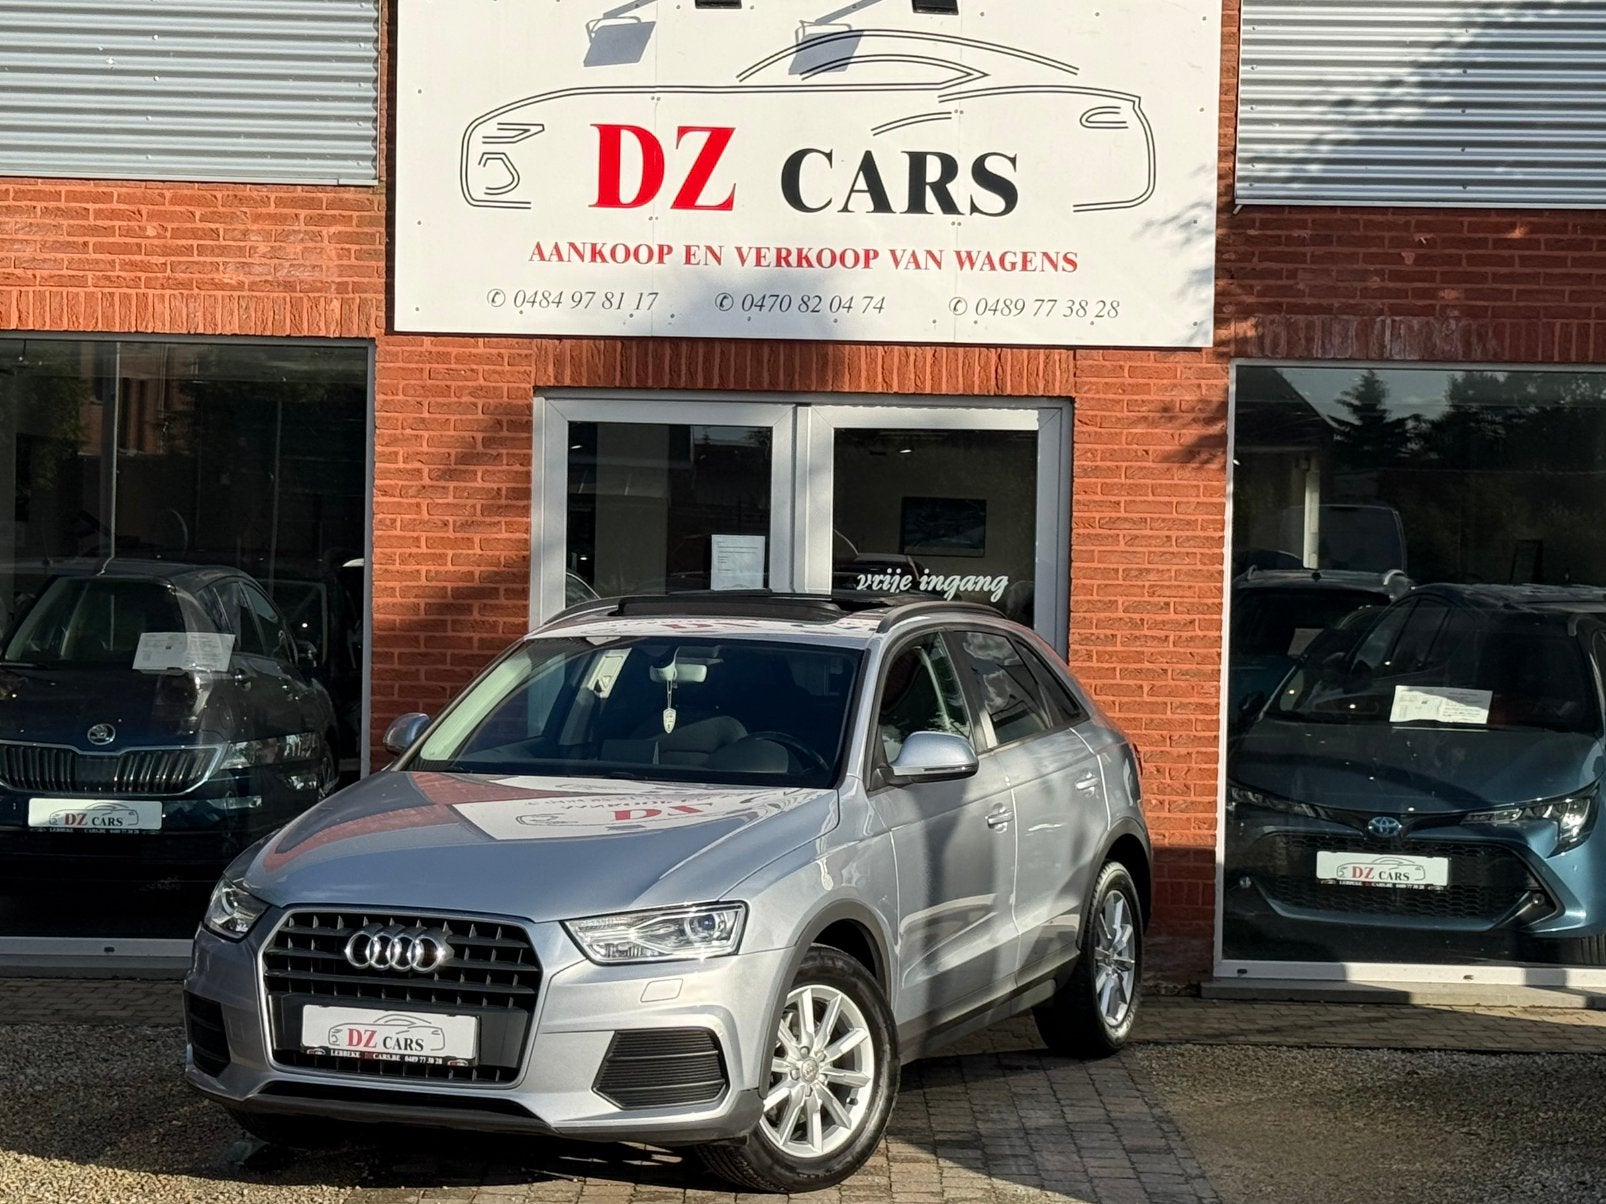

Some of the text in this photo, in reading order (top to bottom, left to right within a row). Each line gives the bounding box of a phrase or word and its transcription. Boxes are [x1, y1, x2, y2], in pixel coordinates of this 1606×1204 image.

[588, 124, 1019, 217] DZ CARS
[529, 240, 1079, 273] AANKOOP EN VERKOOP VAN WAGENS
[513, 289, 659, 311] 0484 97 81 17
[741, 293, 886, 314] 0470 82 04 74
[975, 297, 1120, 318] 0489 77 38 28
[856, 567, 1009, 603] vrije ingang
[64, 812, 124, 827] DZ CARS
[1351, 865, 1410, 881] DZ CARS
[347, 1027, 424, 1052] DZ CARS
